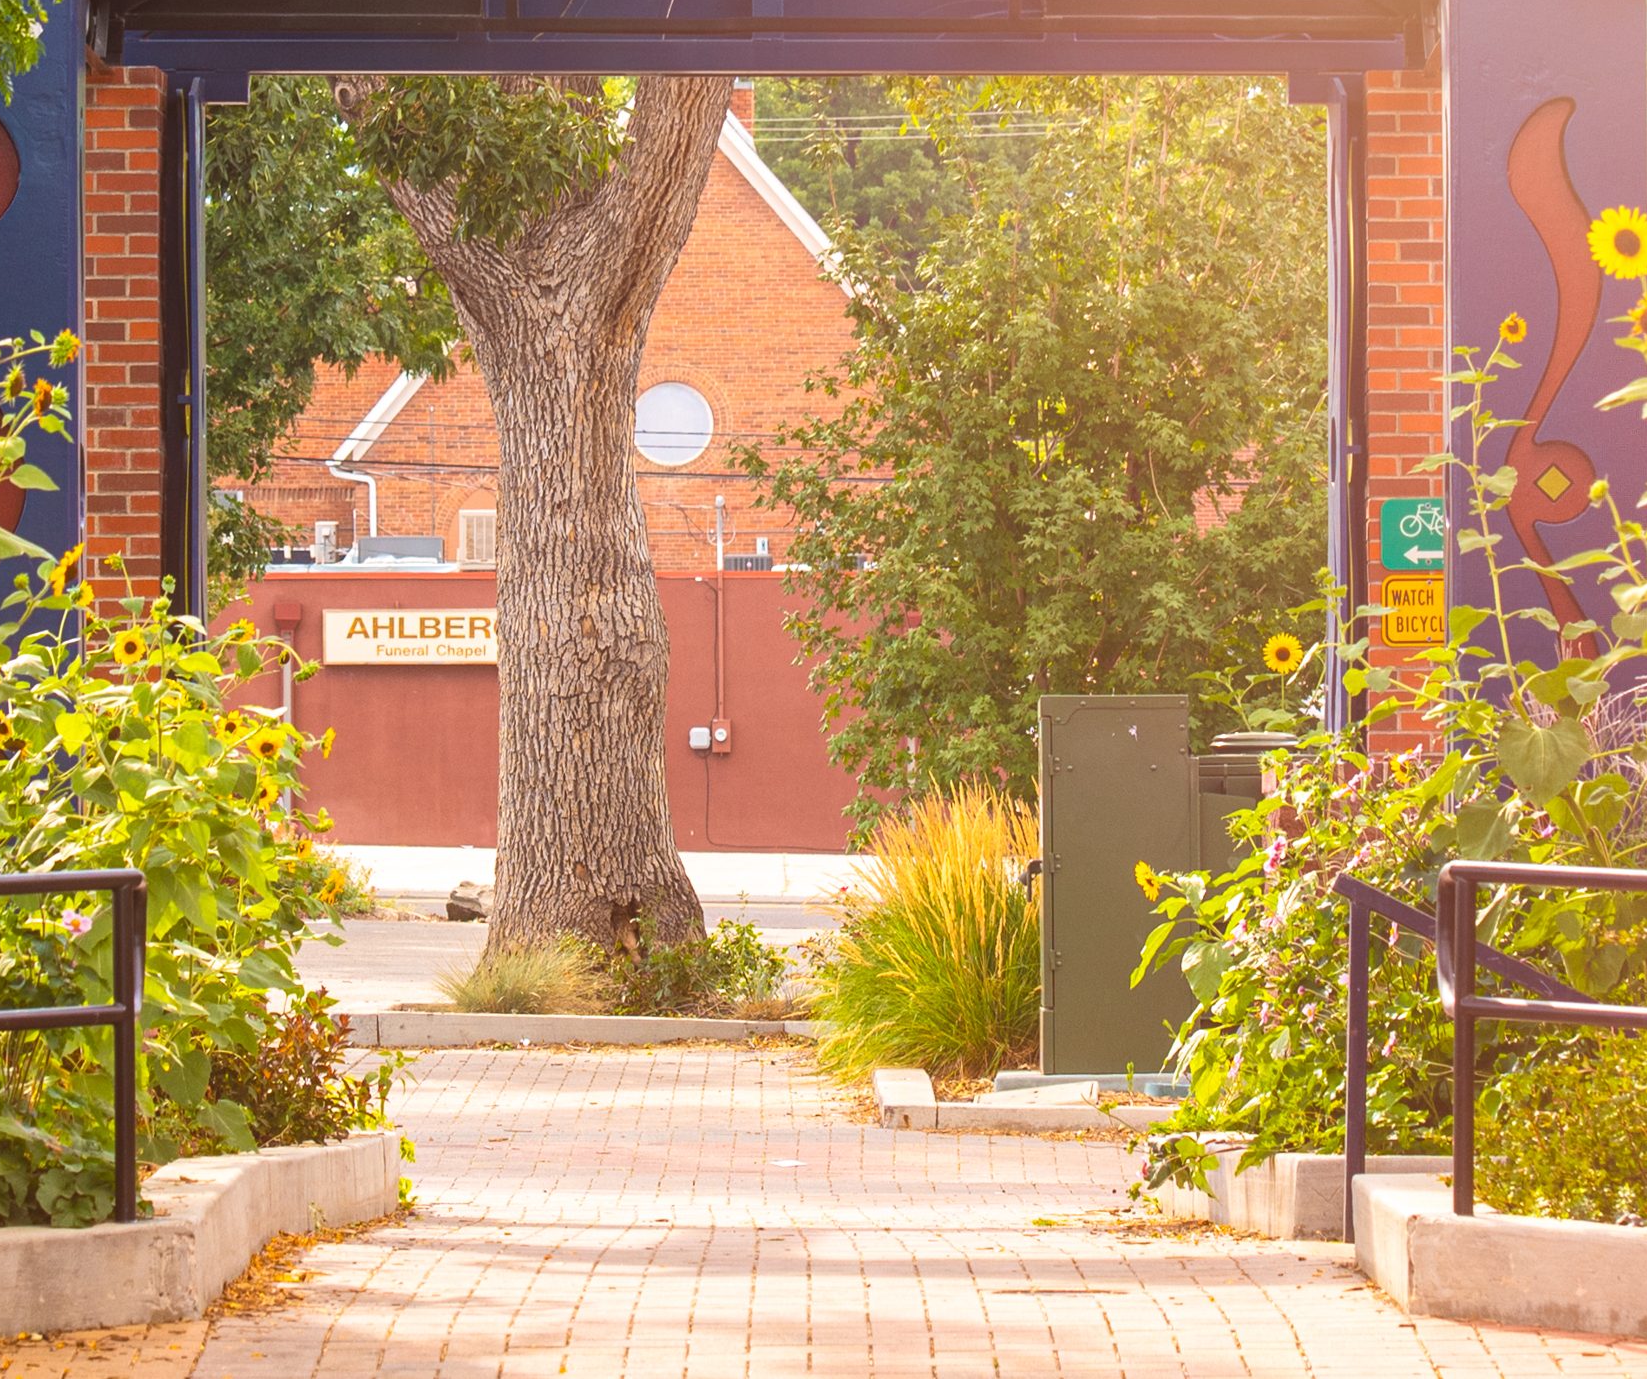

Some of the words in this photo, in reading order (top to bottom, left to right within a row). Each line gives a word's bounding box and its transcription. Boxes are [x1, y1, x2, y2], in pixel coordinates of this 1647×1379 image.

[1392, 589, 1434, 606] WATCH
[346, 616, 498, 639] AHLBER
[376, 644, 429, 657] Funeral
[436, 644, 487, 659] Chapel
